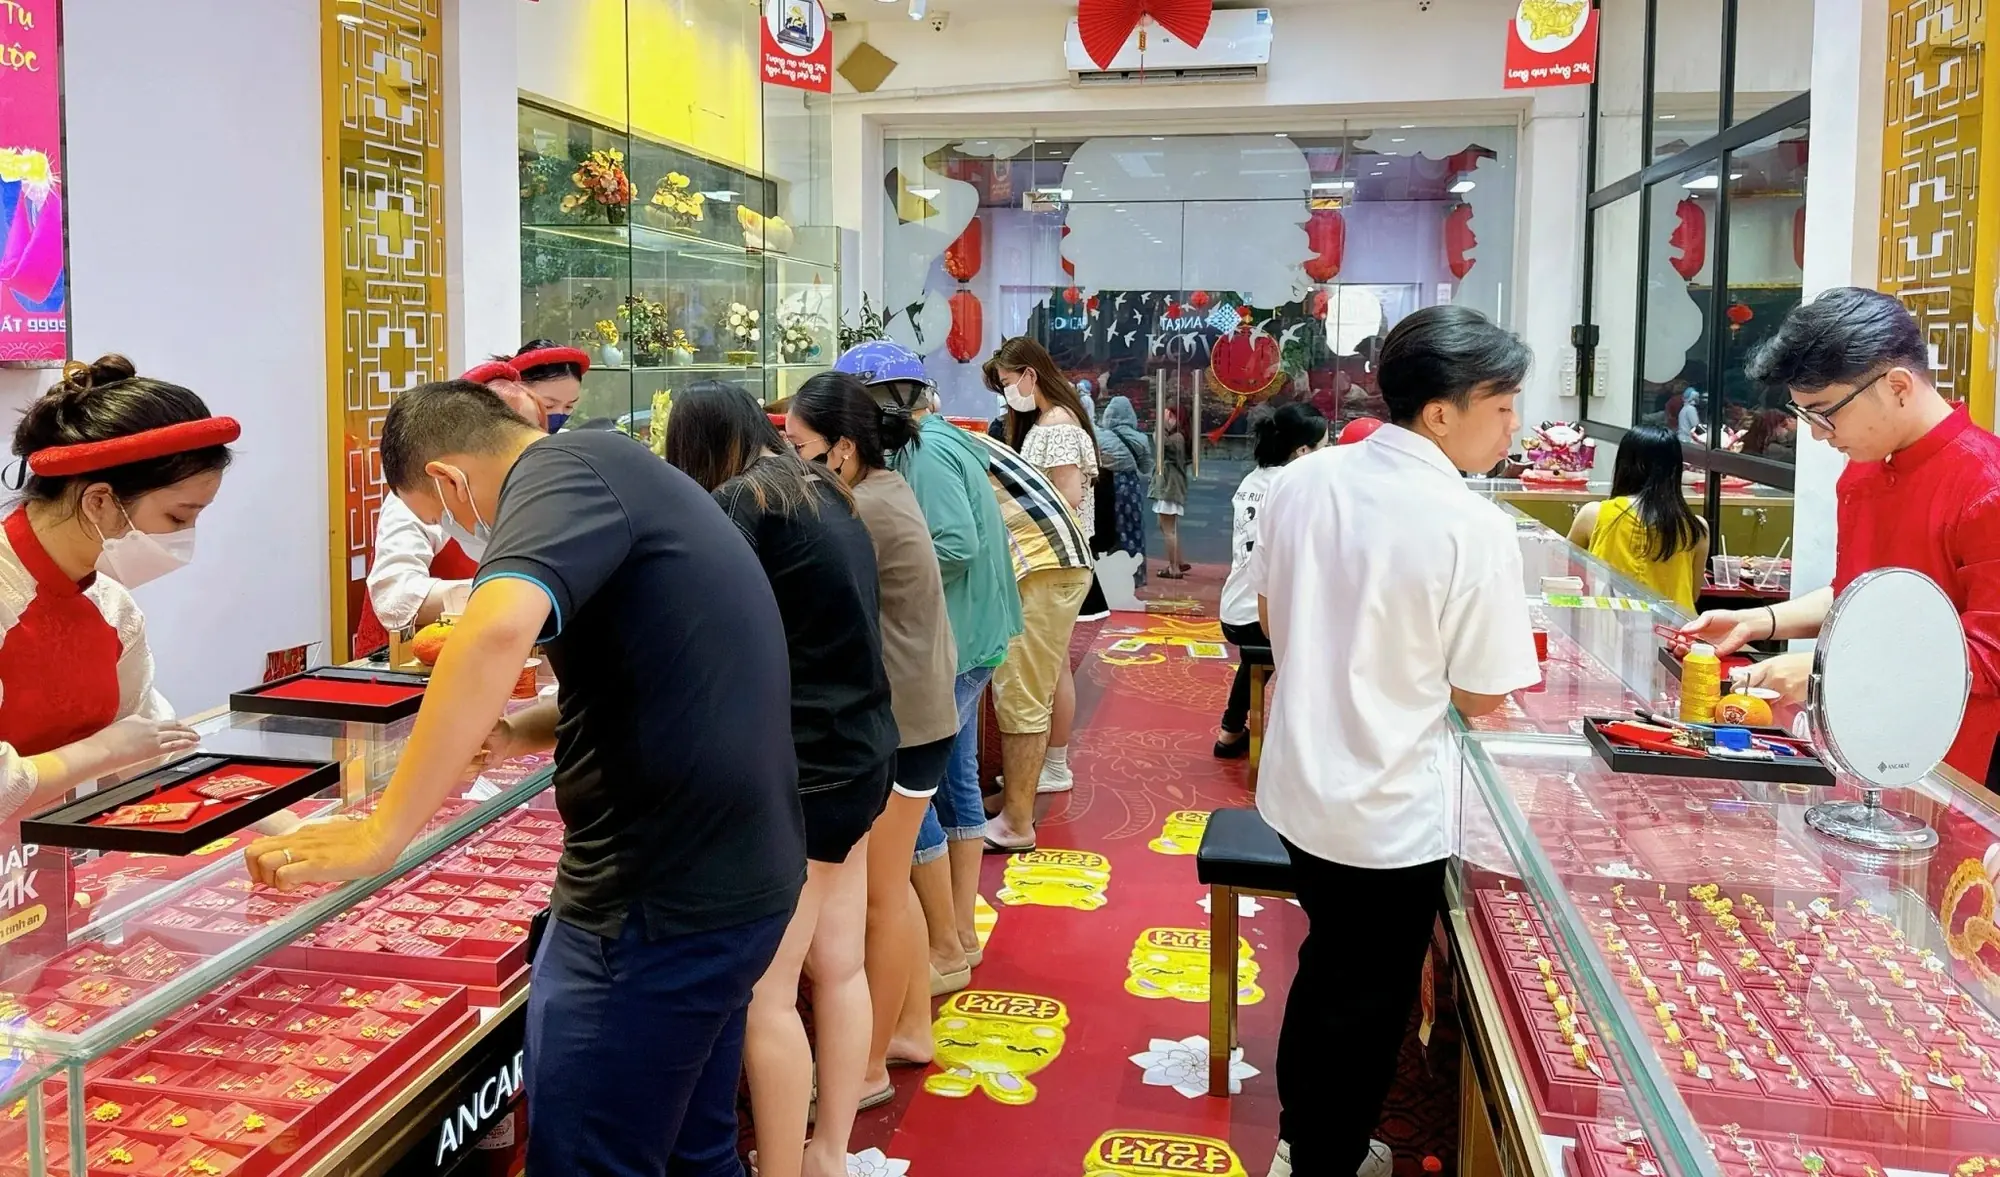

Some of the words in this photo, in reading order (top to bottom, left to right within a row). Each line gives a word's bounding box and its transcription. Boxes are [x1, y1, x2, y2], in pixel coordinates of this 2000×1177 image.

[0, 844, 39, 877] ÁP
[958, 993, 1057, 1019] 招财
[1104, 1136, 1227, 1173] 招财
